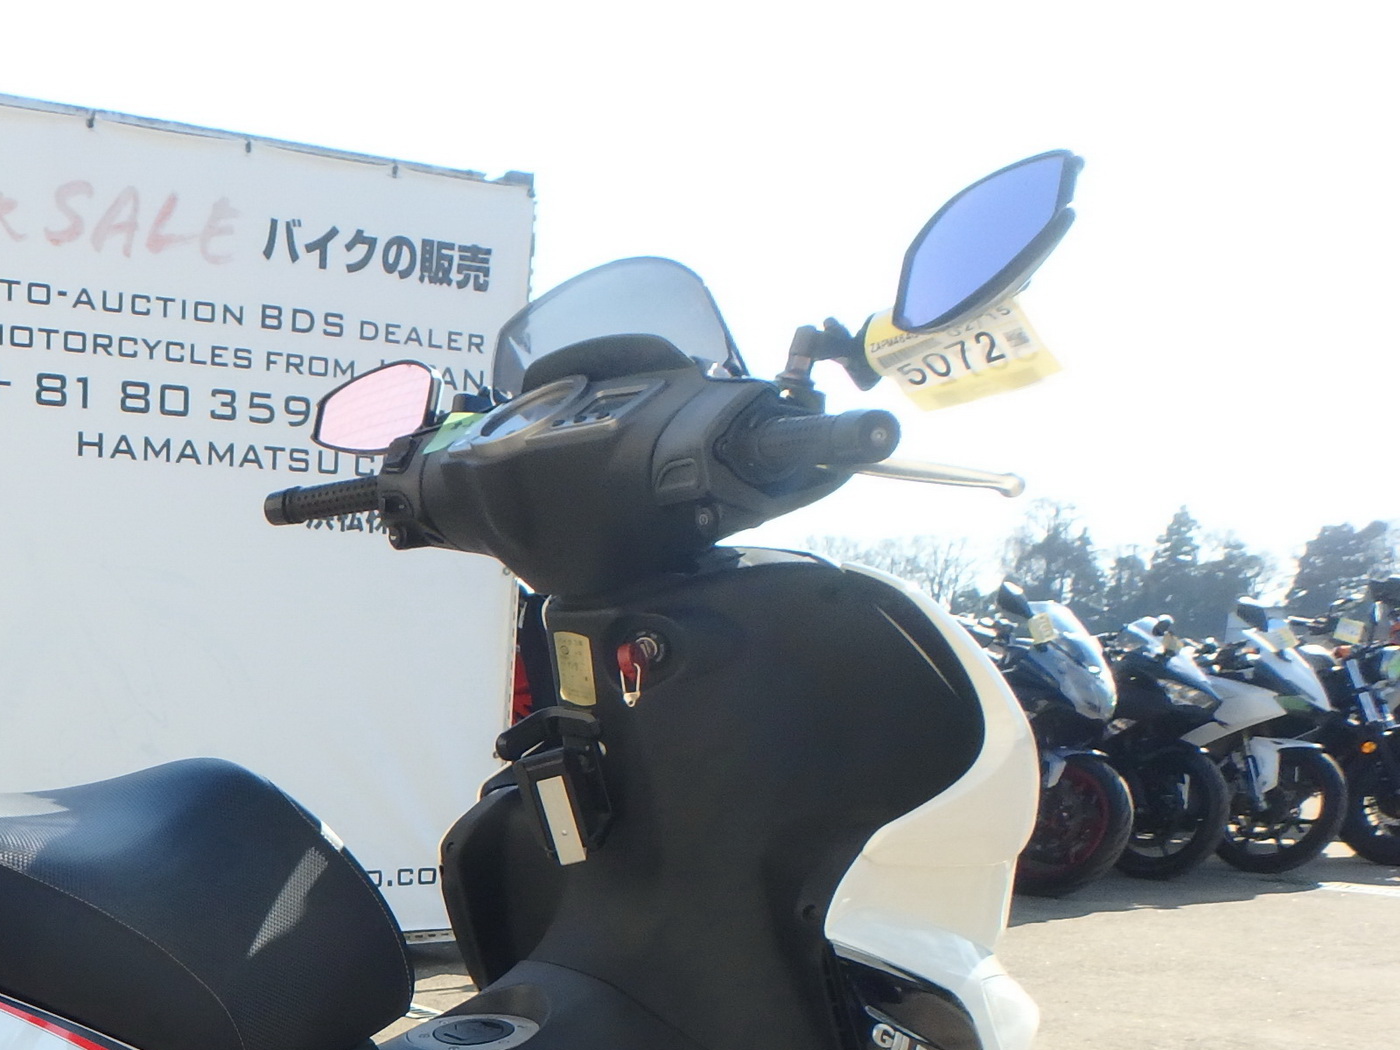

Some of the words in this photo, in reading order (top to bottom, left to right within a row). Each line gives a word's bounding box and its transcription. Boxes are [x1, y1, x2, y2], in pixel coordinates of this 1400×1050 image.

[44, 178, 241, 264] SALE
[264, 216, 492, 292] バイクの販売
[260, 304, 345, 338] BDS
[358, 319, 485, 354] DEALER
[266, 351, 355, 380] FROM
[897, 331, 1006, 386] 5072
[35, 372, 90, 409] 81
[120, 381, 190, 418] 80
[209, 390, 311, 427] 359
[77, 431, 339, 475] HAMAMATSU
